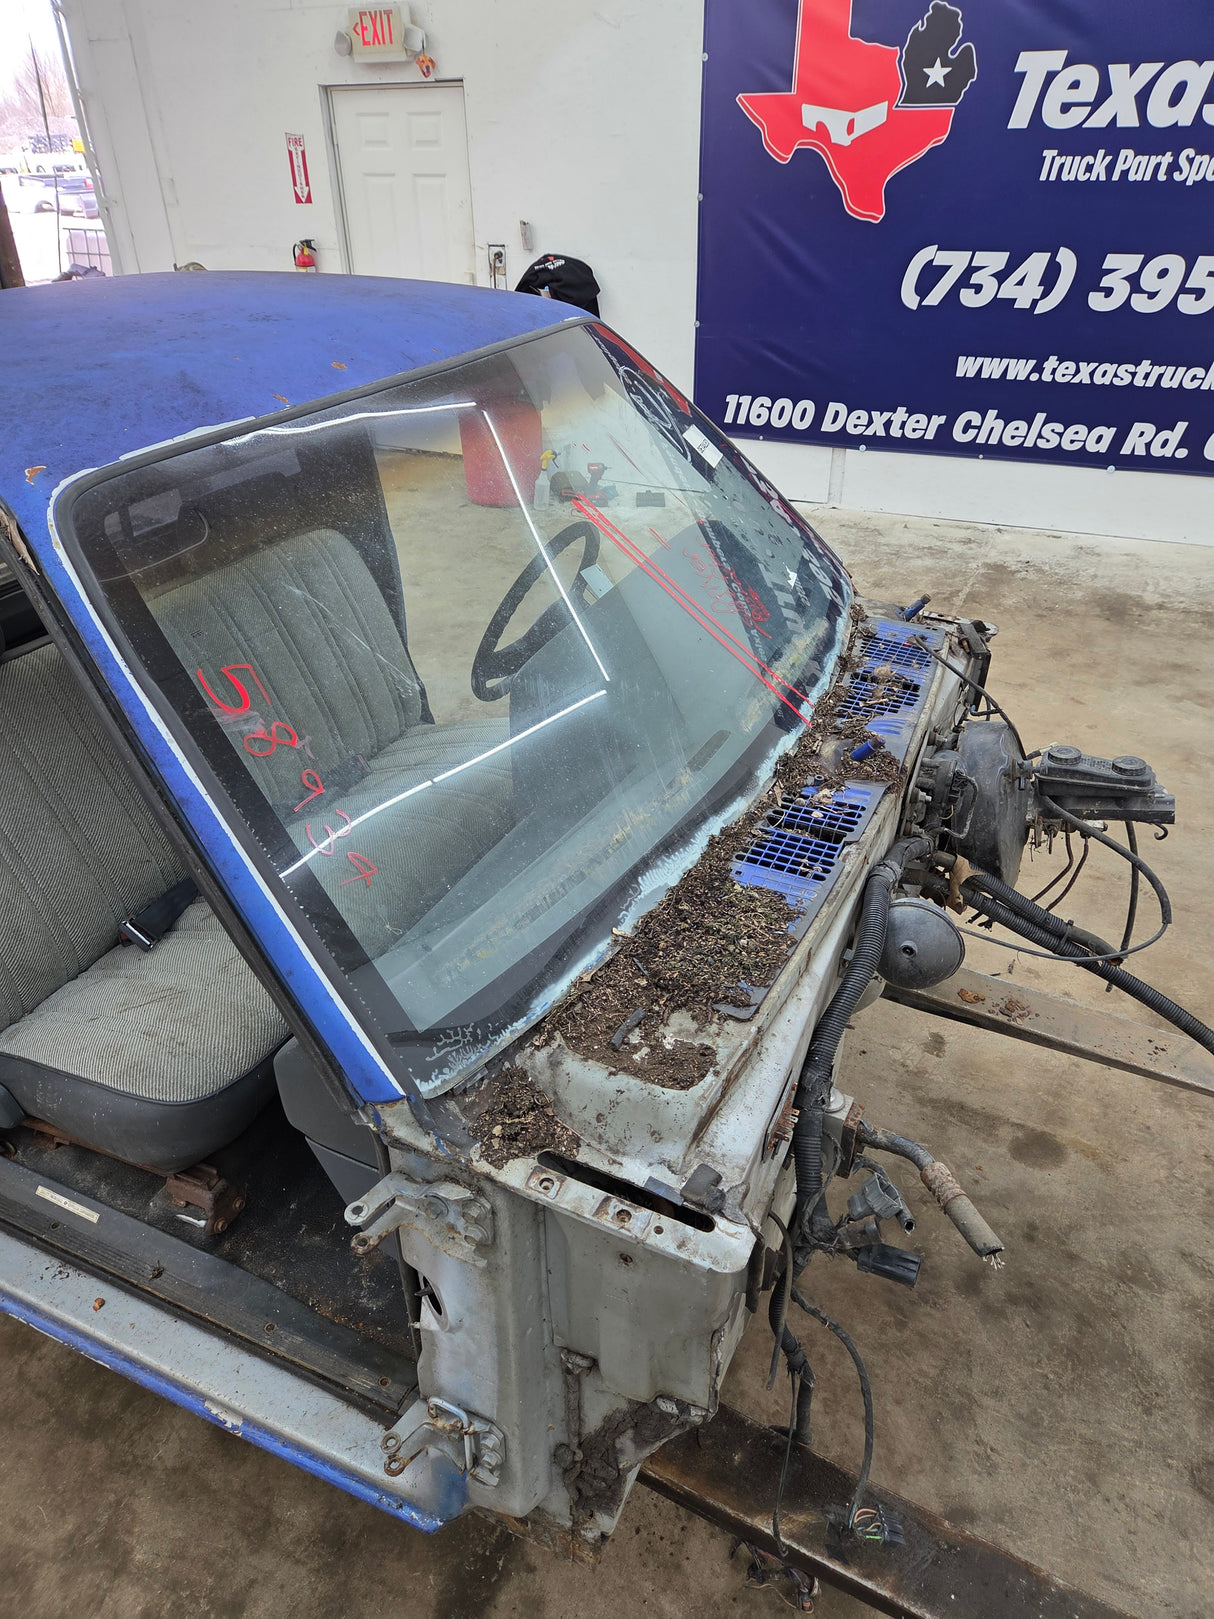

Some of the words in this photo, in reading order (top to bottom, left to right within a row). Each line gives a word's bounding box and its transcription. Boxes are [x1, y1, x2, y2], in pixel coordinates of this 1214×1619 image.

[359, 9, 393, 46] EXIT
[1007, 50, 1214, 130] Texa
[288, 137, 302, 147] FIRE
[1039, 149, 1112, 181] Truck
[1112, 149, 1173, 182] Part
[901, 245, 1077, 315] (734)
[1088, 254, 1214, 315] 395
[724, 394, 815, 430] 11600
[821, 401, 946, 440] Dexter
[953, 410, 1116, 453] Chelsea
[1119, 421, 1189, 459] Rd.
